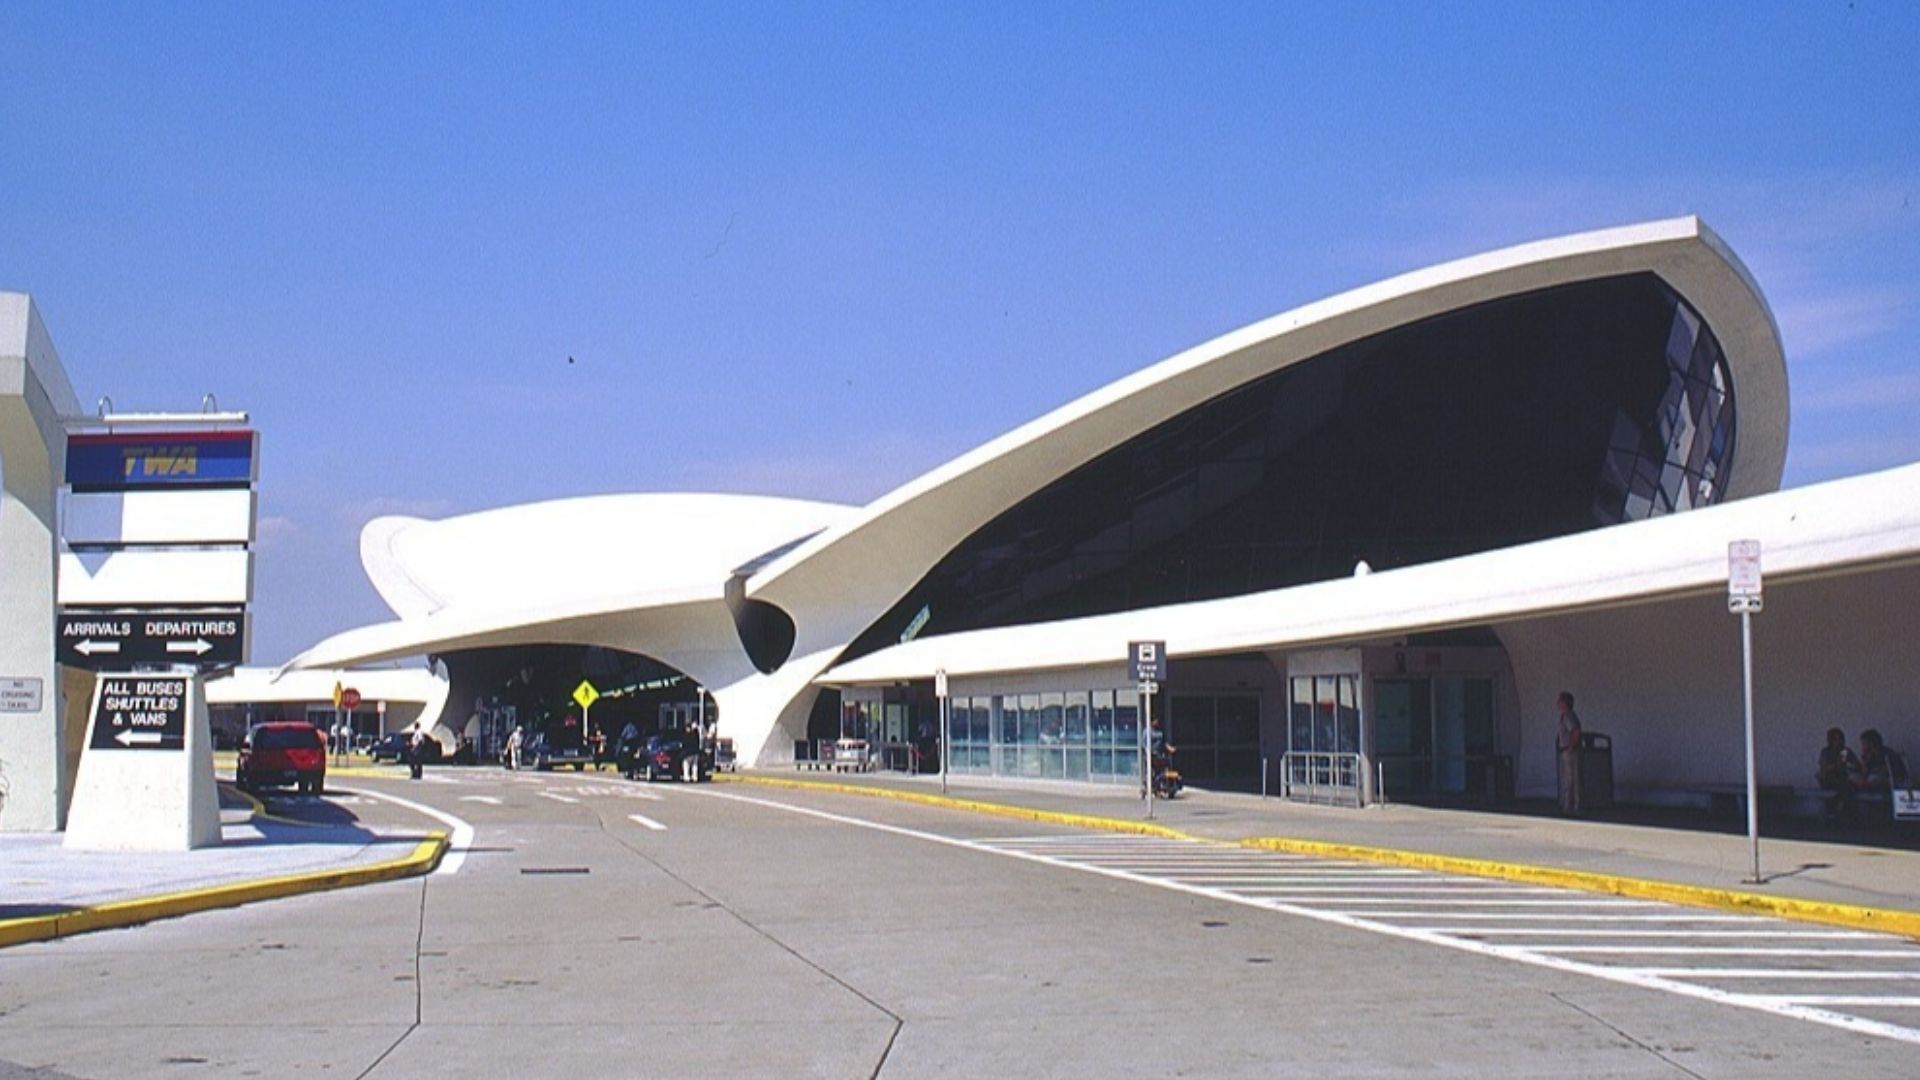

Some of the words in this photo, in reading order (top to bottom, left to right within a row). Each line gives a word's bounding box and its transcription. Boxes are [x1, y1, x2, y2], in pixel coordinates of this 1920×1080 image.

[123, 447, 197, 476] TWA
[64, 622, 131, 636] ARRIVALS
[145, 622, 236, 636] DEPARTURES
[104, 682, 130, 695] ALL
[136, 682, 184, 695] BUSES
[105, 697, 178, 710] SHUTTLES
[112, 712, 123, 725] &
[130, 712, 168, 726] VANS
